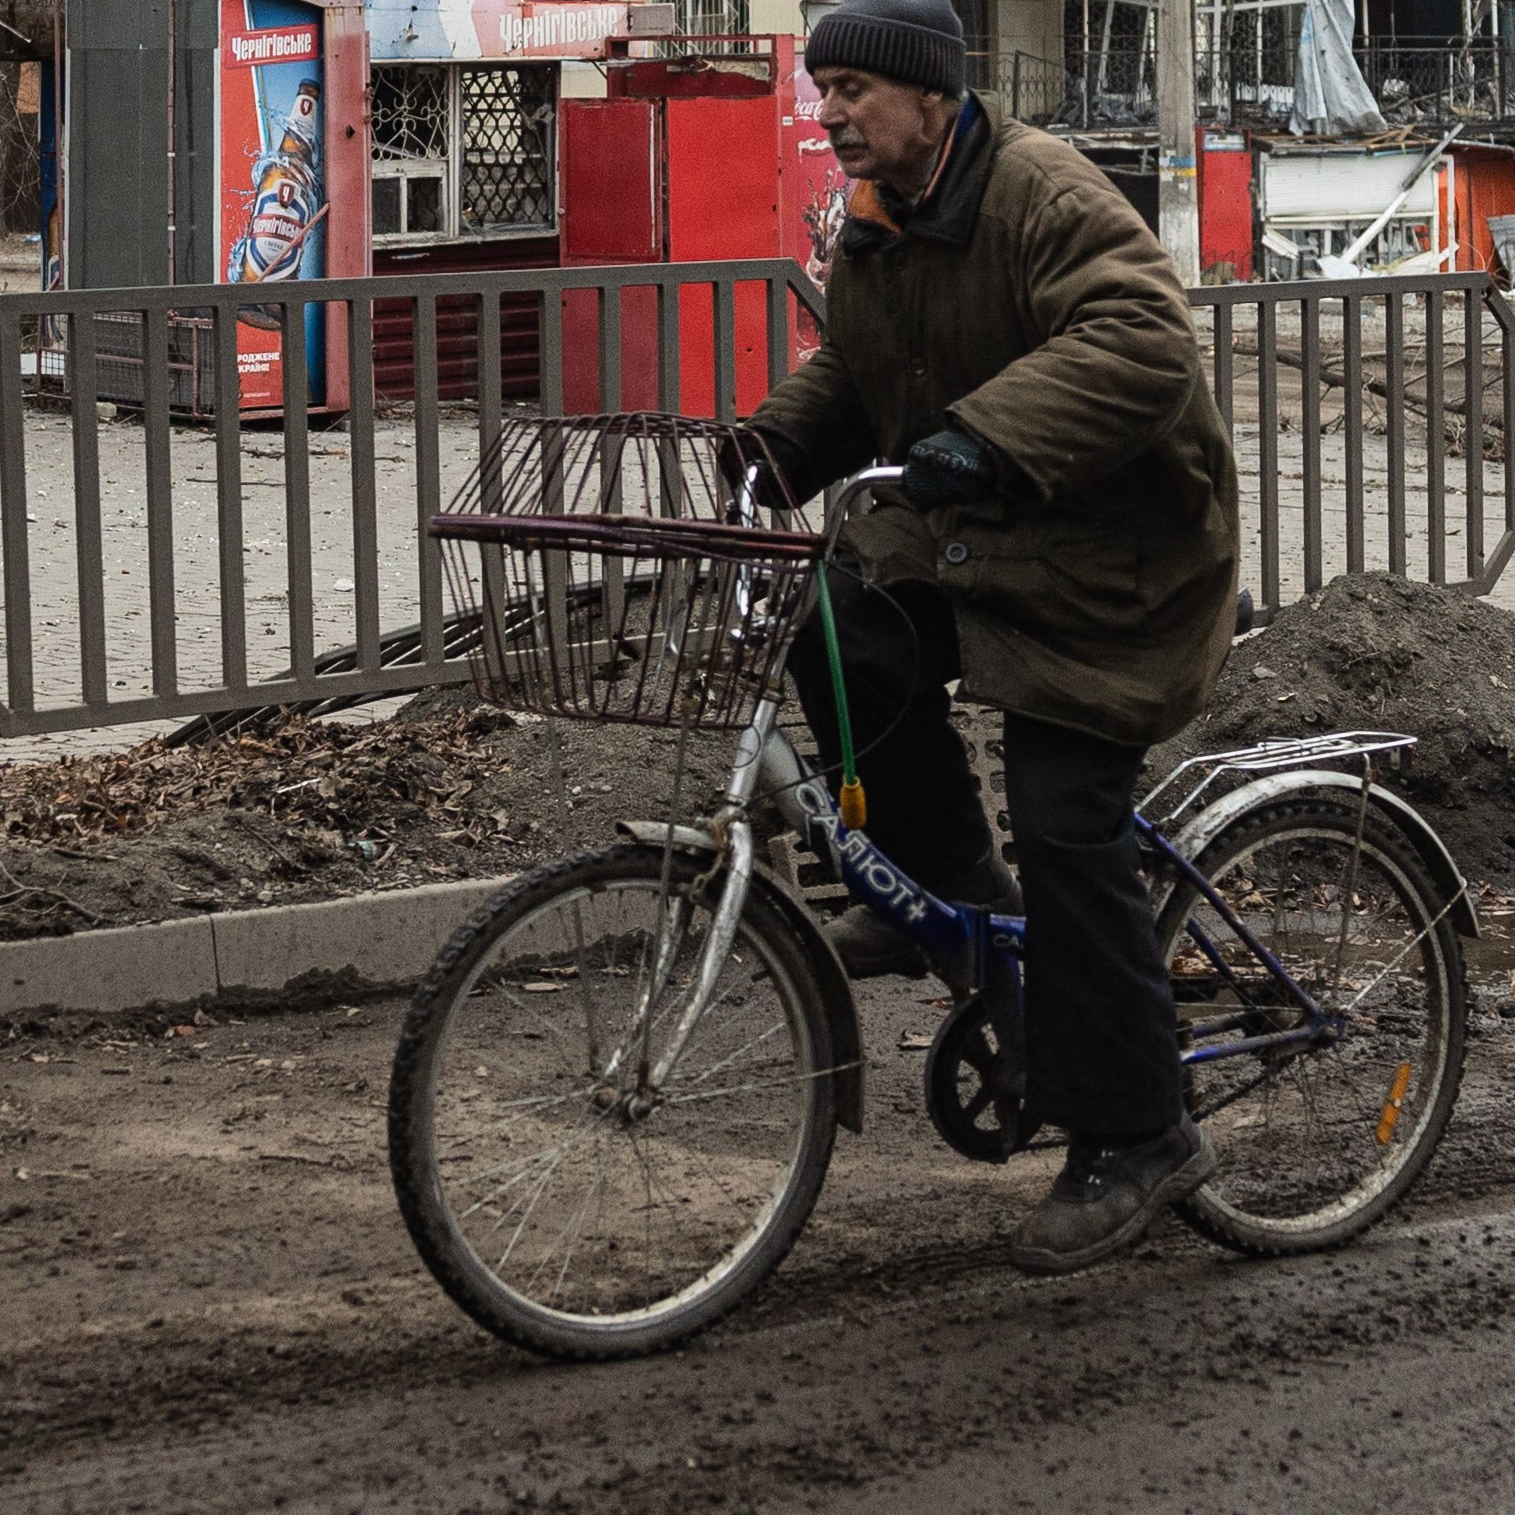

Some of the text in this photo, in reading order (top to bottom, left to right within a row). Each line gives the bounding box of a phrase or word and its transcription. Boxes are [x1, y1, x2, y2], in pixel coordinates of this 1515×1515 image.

[500, 6, 618, 52] Чернігівське
[231, 32, 313, 62] Чернігівське
[237, 352, 280, 363] РОДЖЕНЕ
